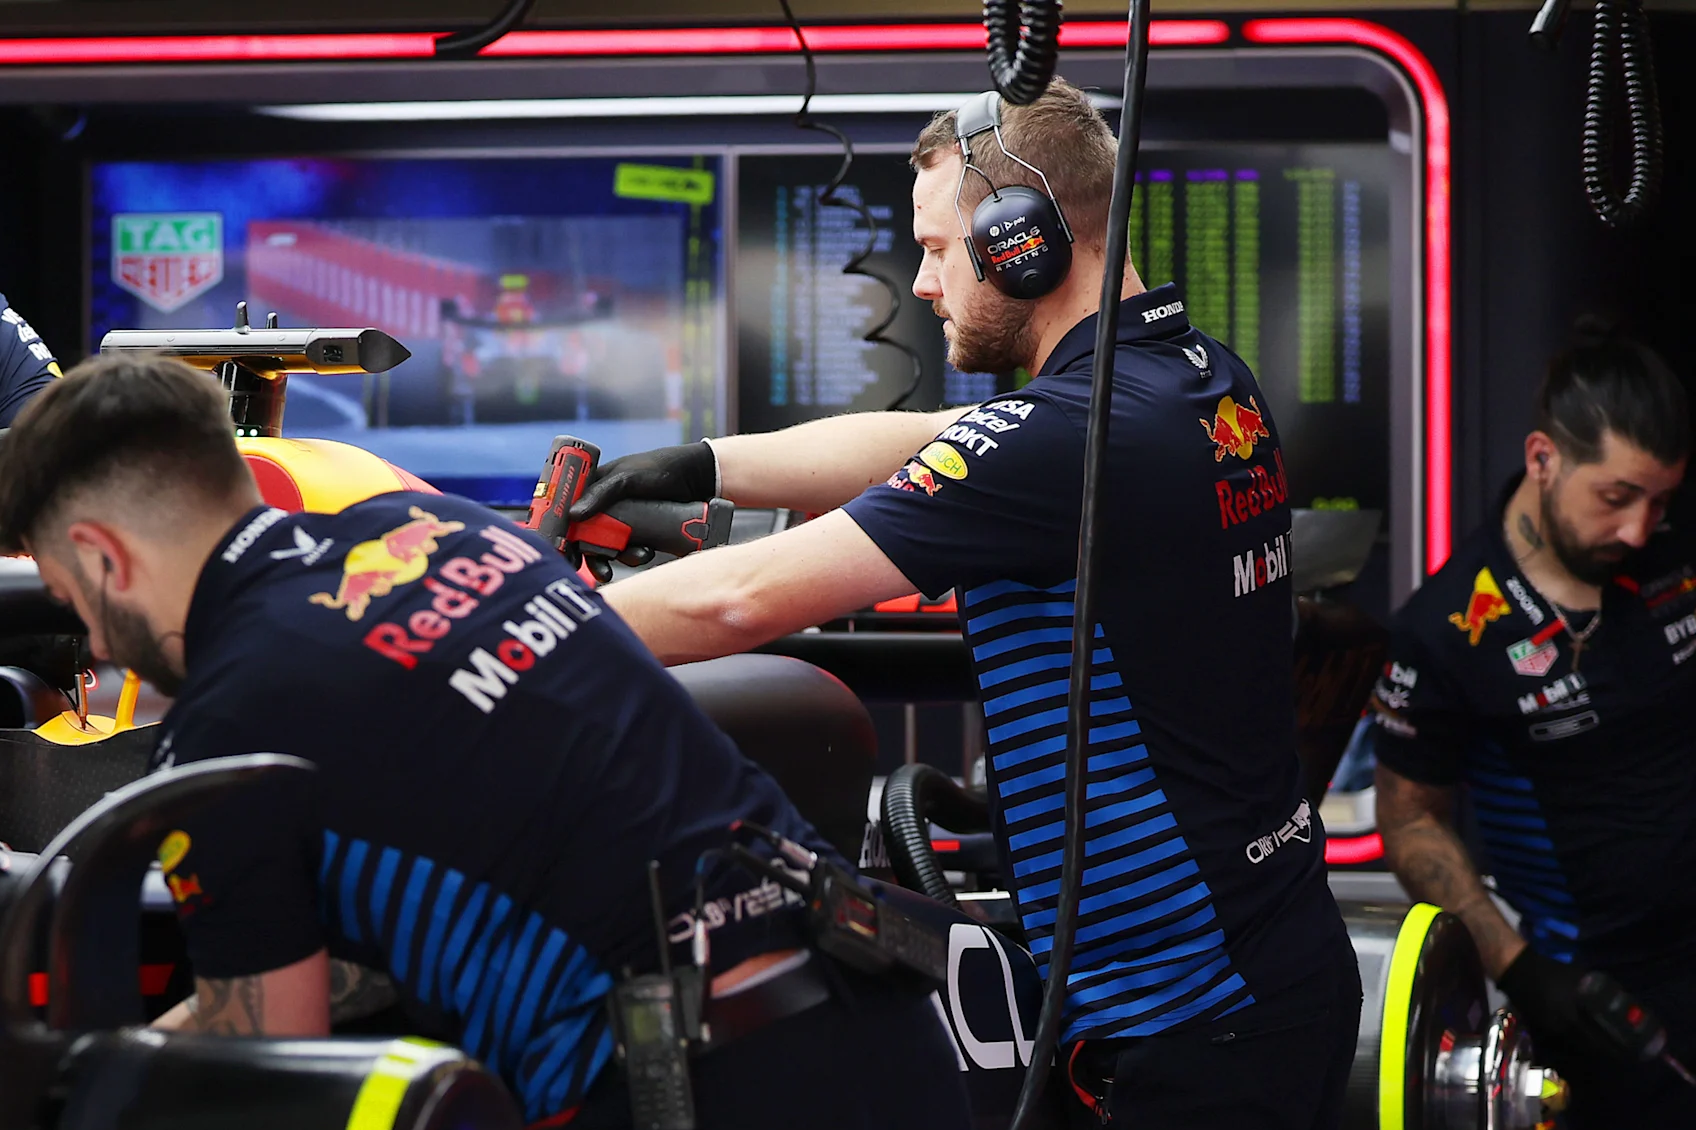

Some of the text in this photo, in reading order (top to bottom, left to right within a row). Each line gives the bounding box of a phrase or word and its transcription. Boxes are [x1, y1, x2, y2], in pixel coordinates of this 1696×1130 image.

[124, 221, 211, 251] TAG
[1233, 534, 1288, 598] Mobil
[449, 594, 578, 714] Mobil
